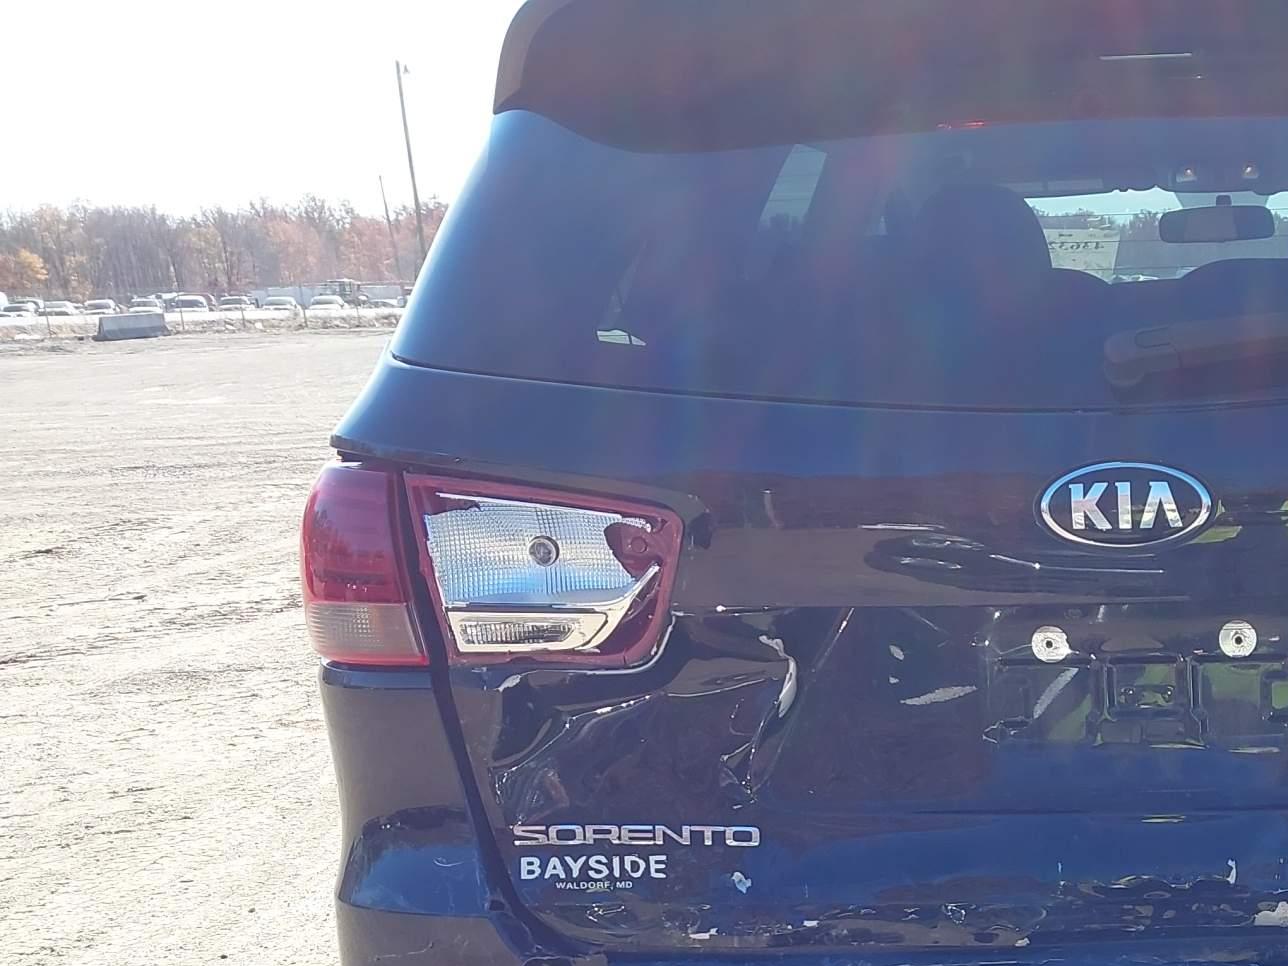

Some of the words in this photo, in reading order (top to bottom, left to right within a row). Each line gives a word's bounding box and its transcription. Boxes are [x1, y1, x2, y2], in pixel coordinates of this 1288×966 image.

[1068, 481, 1184, 530] KIA
[511, 824, 760, 847] SORENTO
[519, 855, 668, 880] BAYSIDE
[555, 881, 614, 890] WALDORF,
[616, 881, 633, 889] MD
